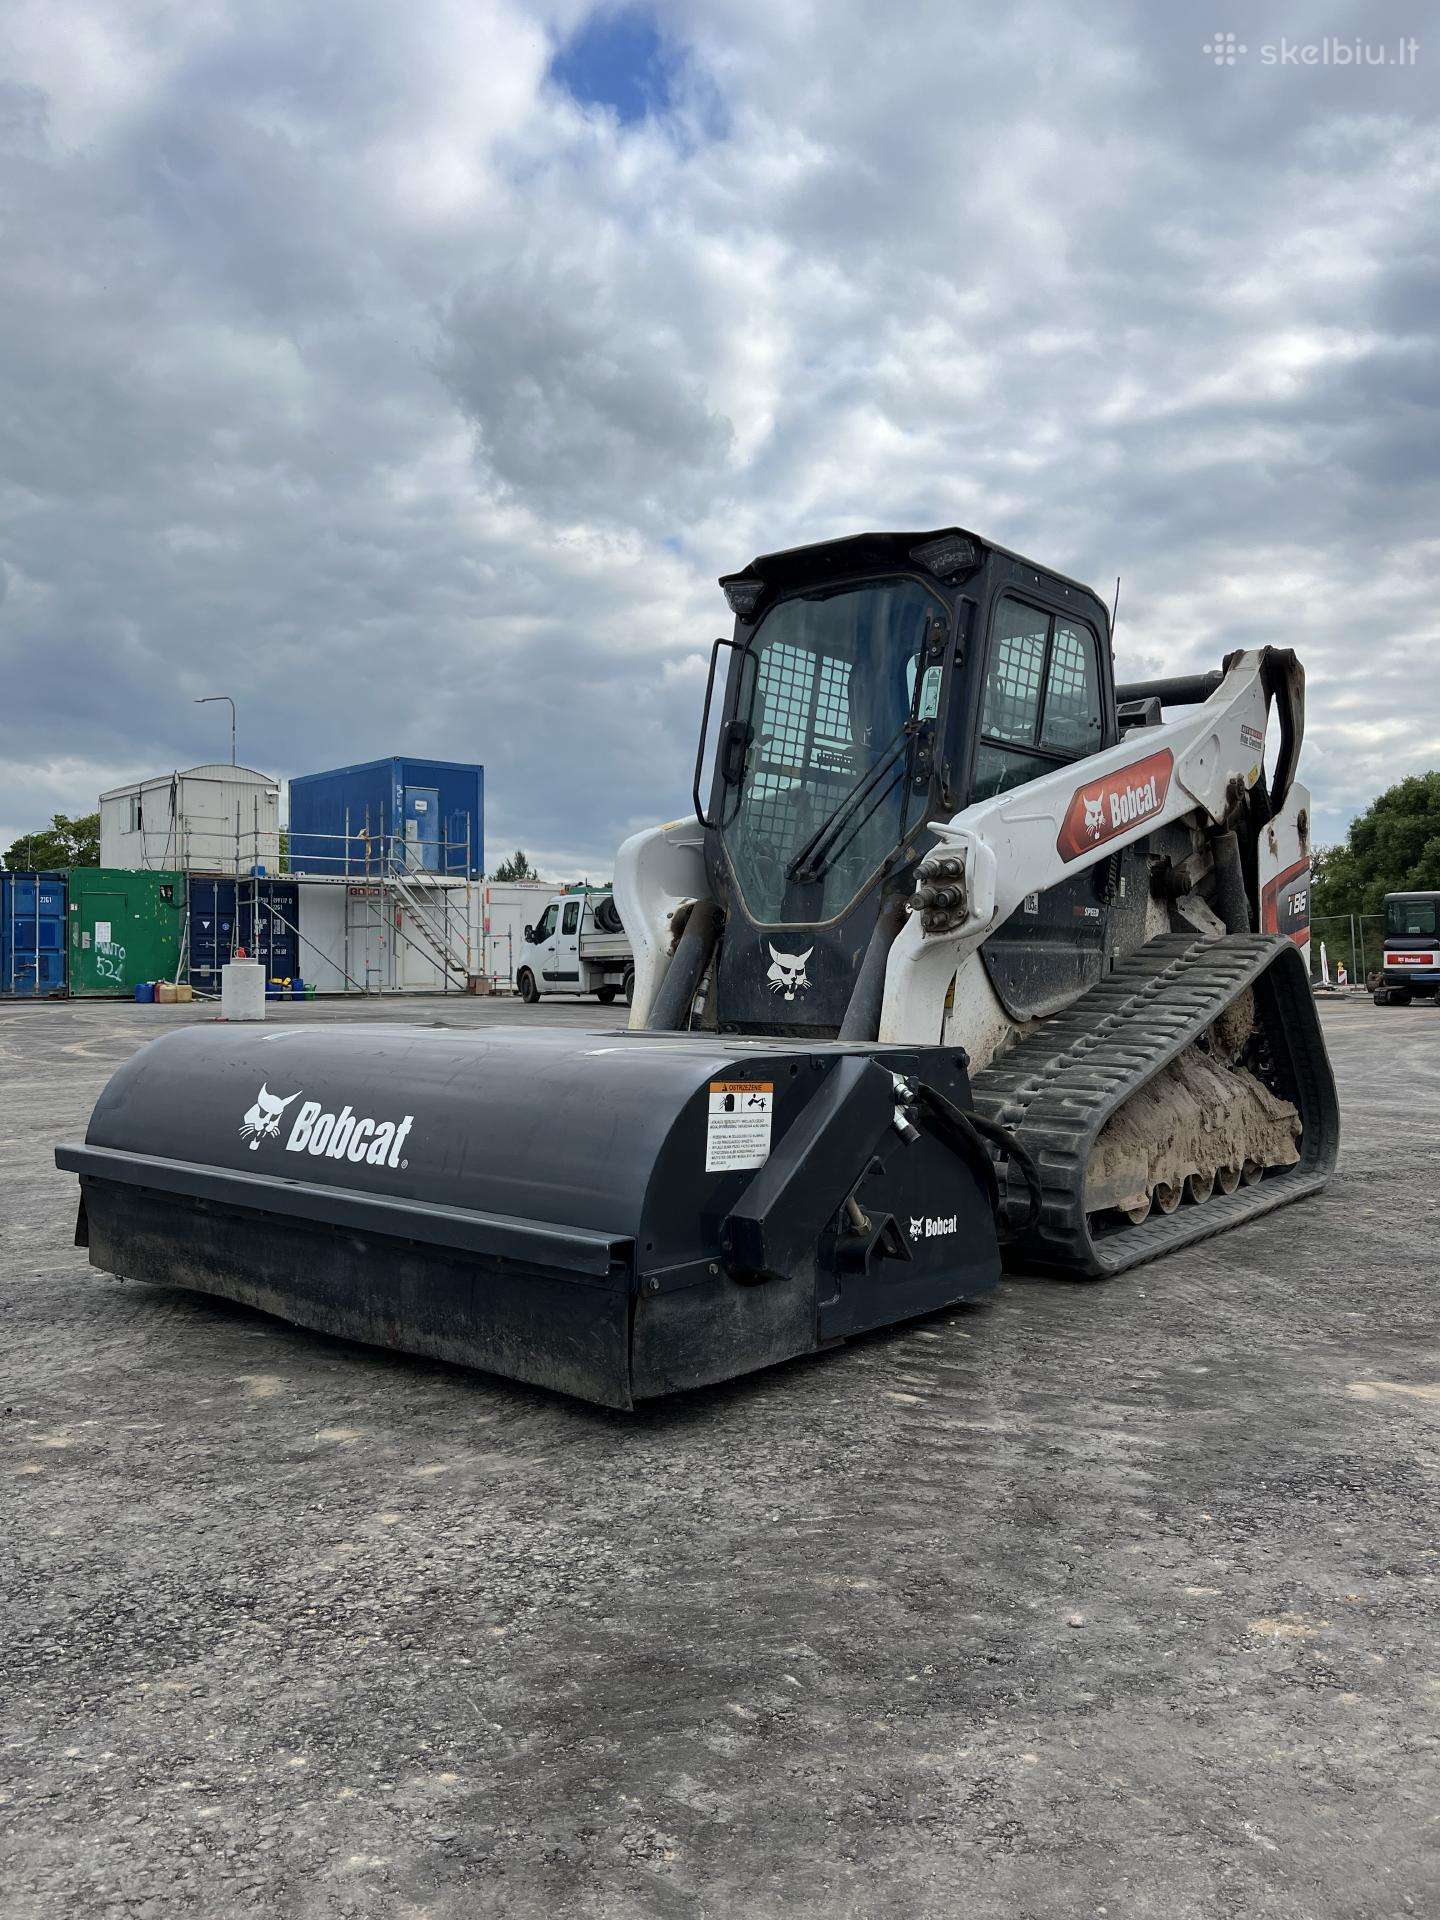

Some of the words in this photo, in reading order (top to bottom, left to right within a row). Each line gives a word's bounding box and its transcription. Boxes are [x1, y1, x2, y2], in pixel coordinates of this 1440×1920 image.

[1109, 775, 1158, 828] Bobcat
[1084, 907, 1100, 917] SPEED
[286, 1101, 415, 1168] Bobcat
[925, 1214, 958, 1238] Bobcat
